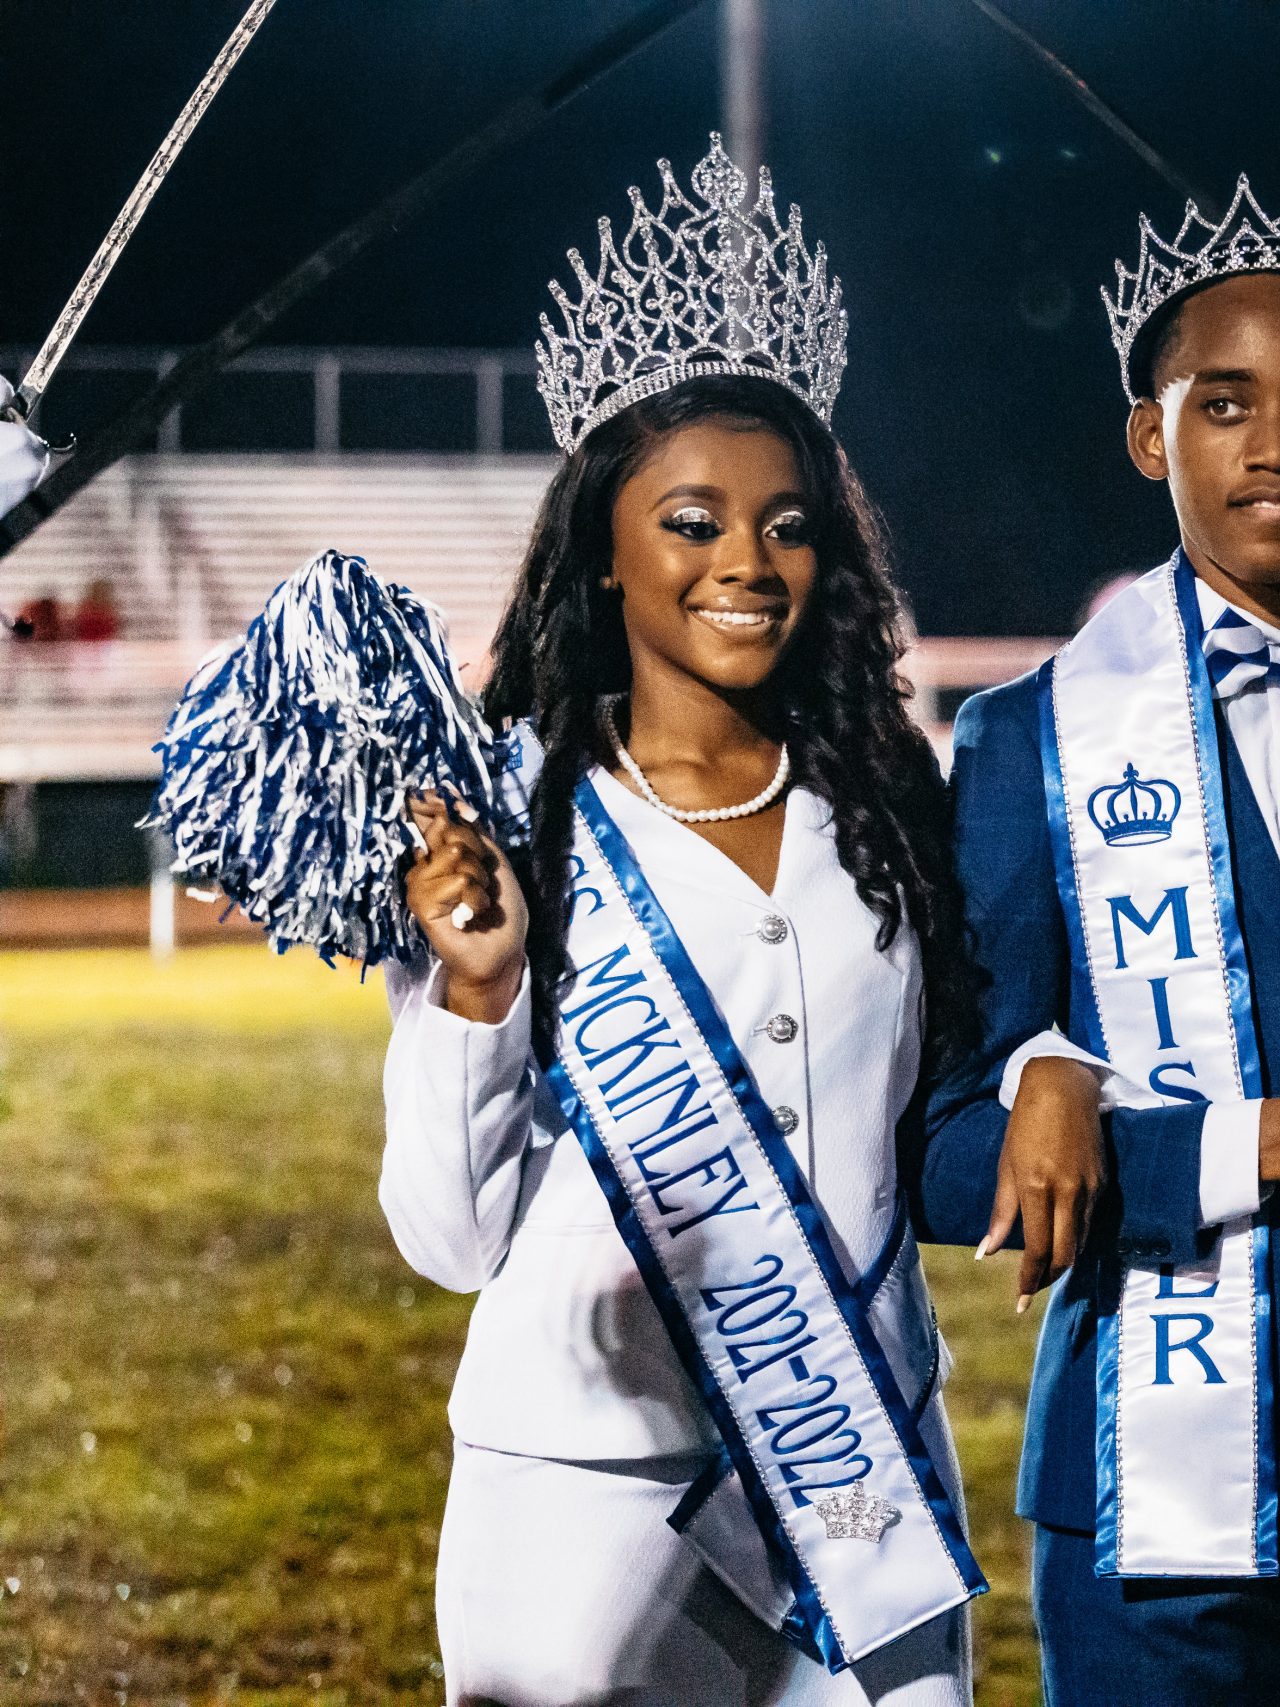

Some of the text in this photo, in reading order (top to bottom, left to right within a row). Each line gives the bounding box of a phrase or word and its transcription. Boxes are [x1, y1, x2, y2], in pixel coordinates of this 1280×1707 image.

[556, 943, 873, 1508] MCKINLEY 2021-2022
[1106, 886, 1228, 1385] MISR
